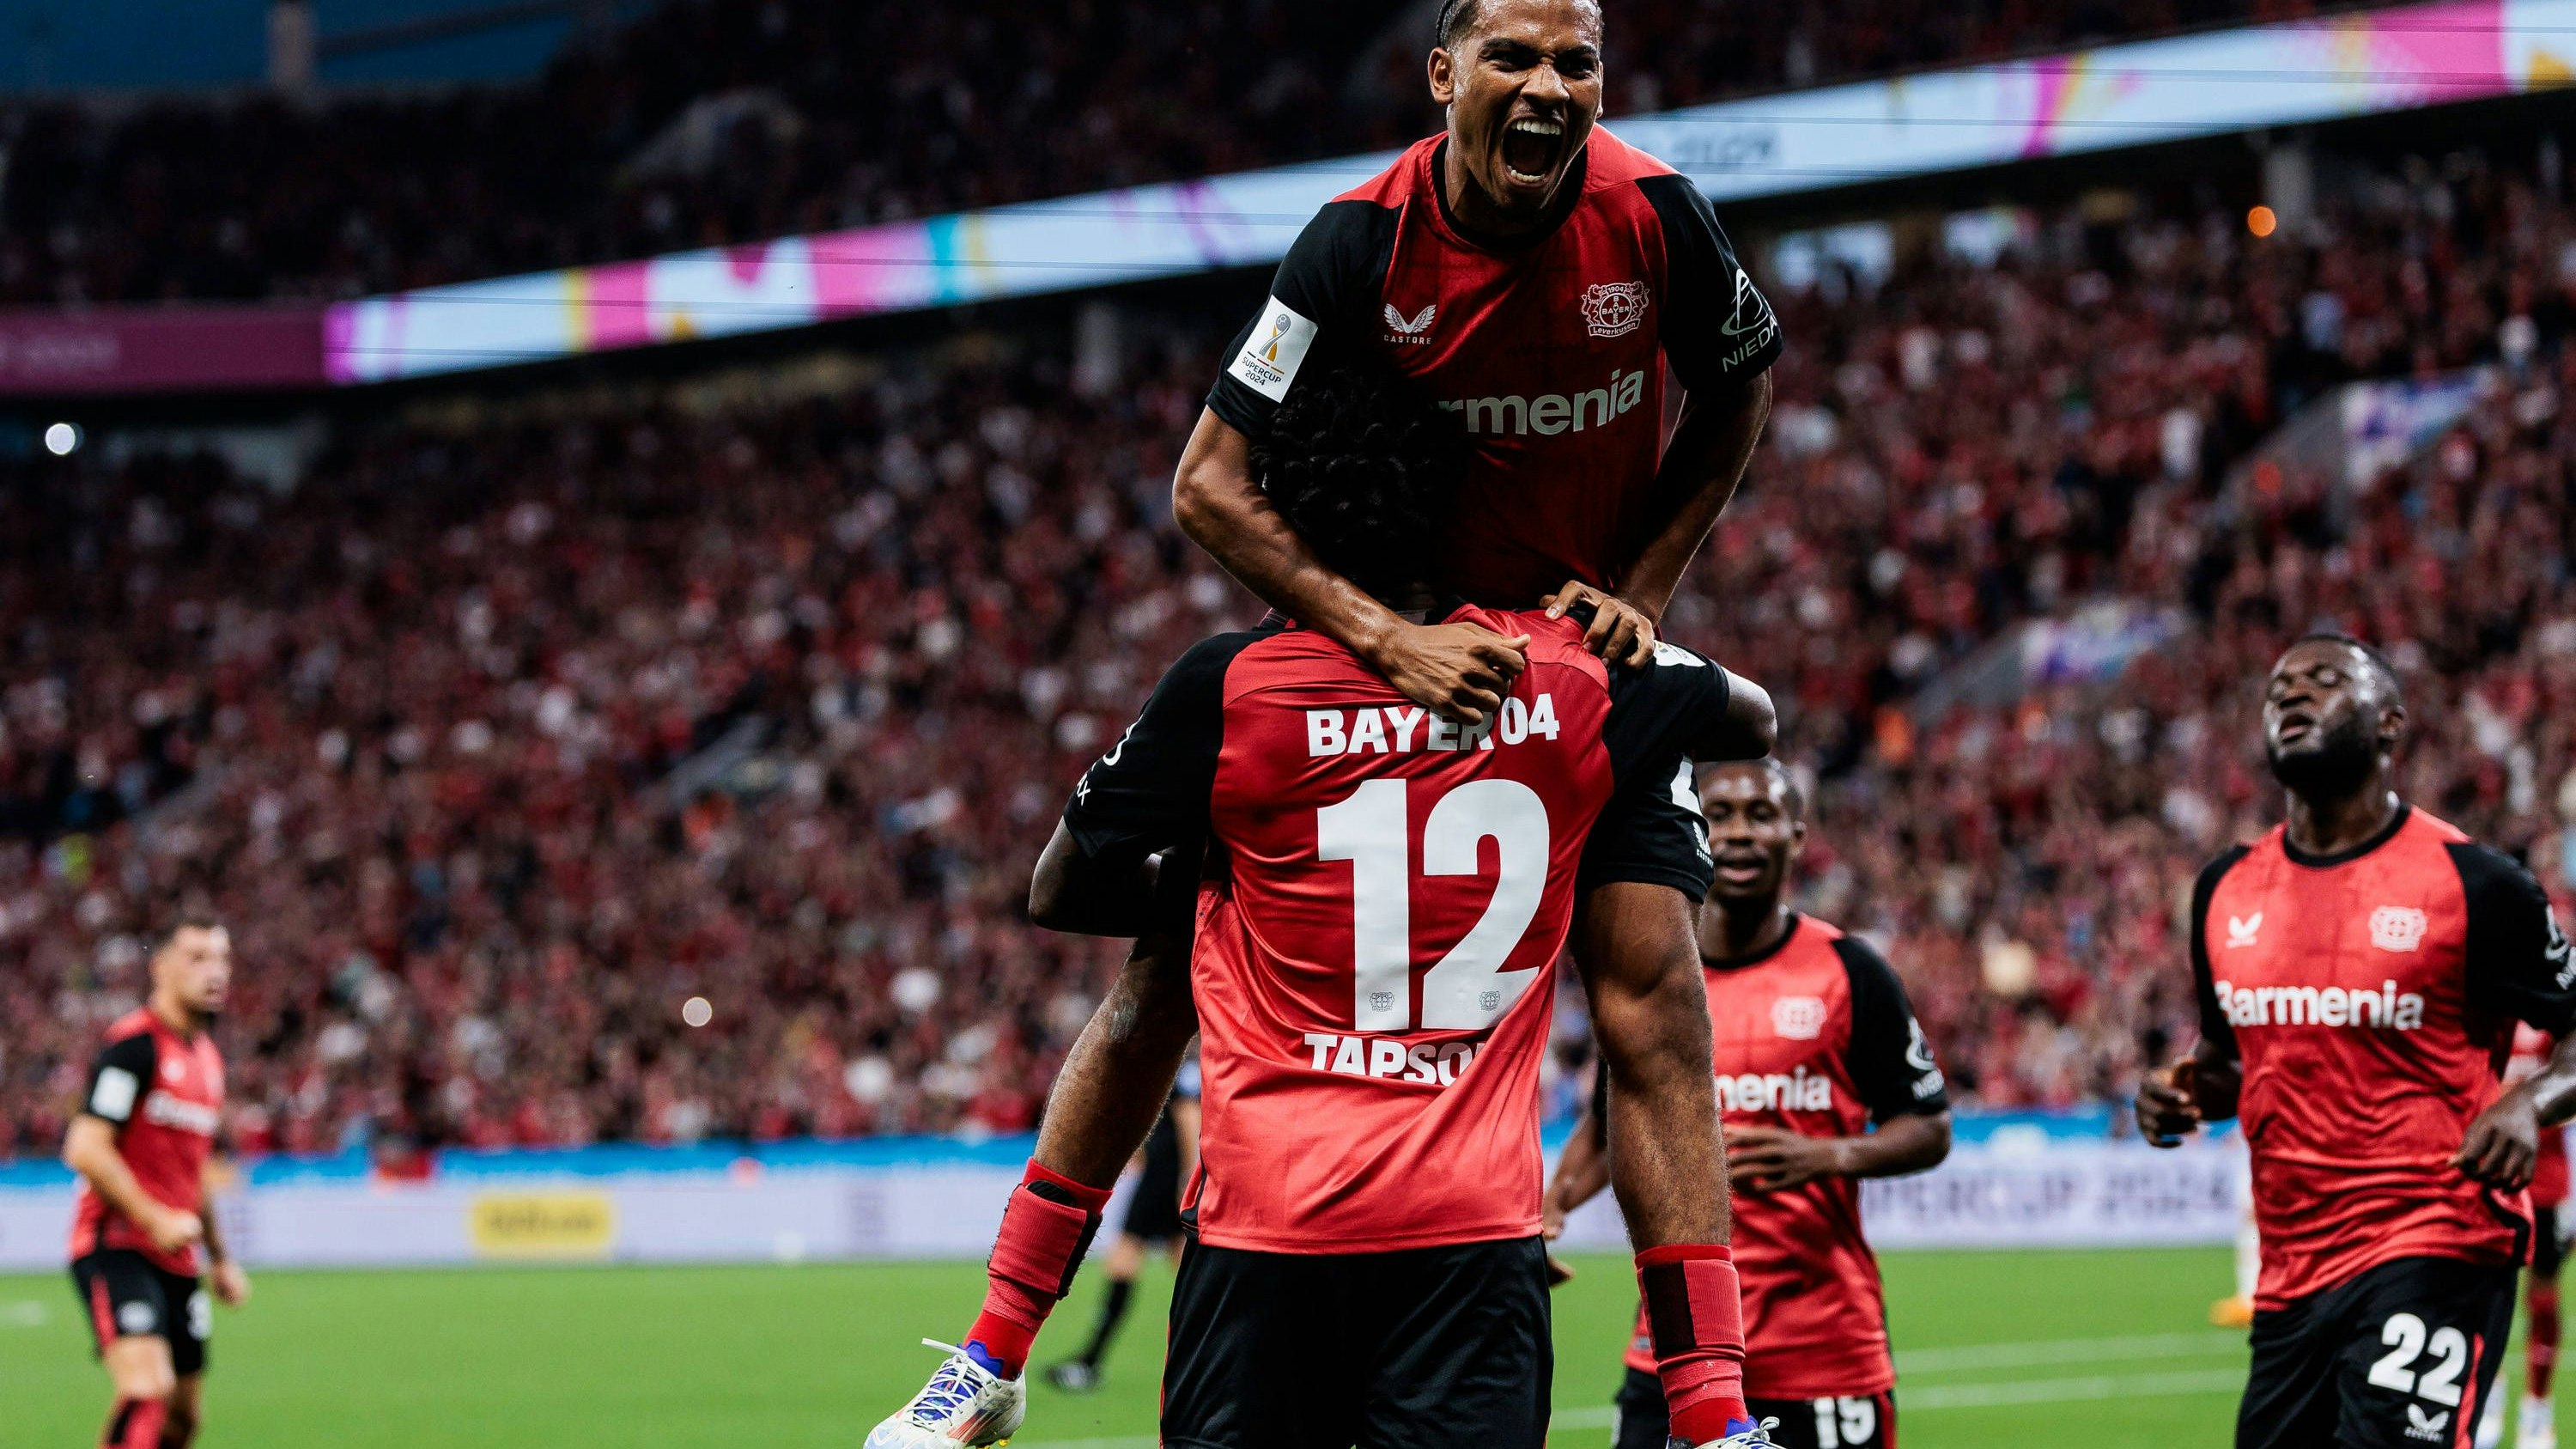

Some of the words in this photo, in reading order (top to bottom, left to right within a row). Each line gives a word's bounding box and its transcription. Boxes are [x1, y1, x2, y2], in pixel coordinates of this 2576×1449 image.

[1607, 285, 1625, 294] 1904
[1593, 323, 1636, 335] Leverkusen
[1601, 306, 1630, 315] BAYER
[1383, 334, 1432, 344] CASTORE
[1242, 356, 1282, 383] SUPERCUP
[1245, 369, 1266, 386] 2024
[1437, 368, 1643, 435] rmenia
[1306, 706, 1495, 757] BAYER
[1500, 692, 1560, 745] 04
[1317, 778, 1550, 1031] 12
[1304, 1032, 1487, 1087] TAPSO
[2367, 1312, 2468, 1407] 22
[1813, 1396, 1876, 1449] 19
